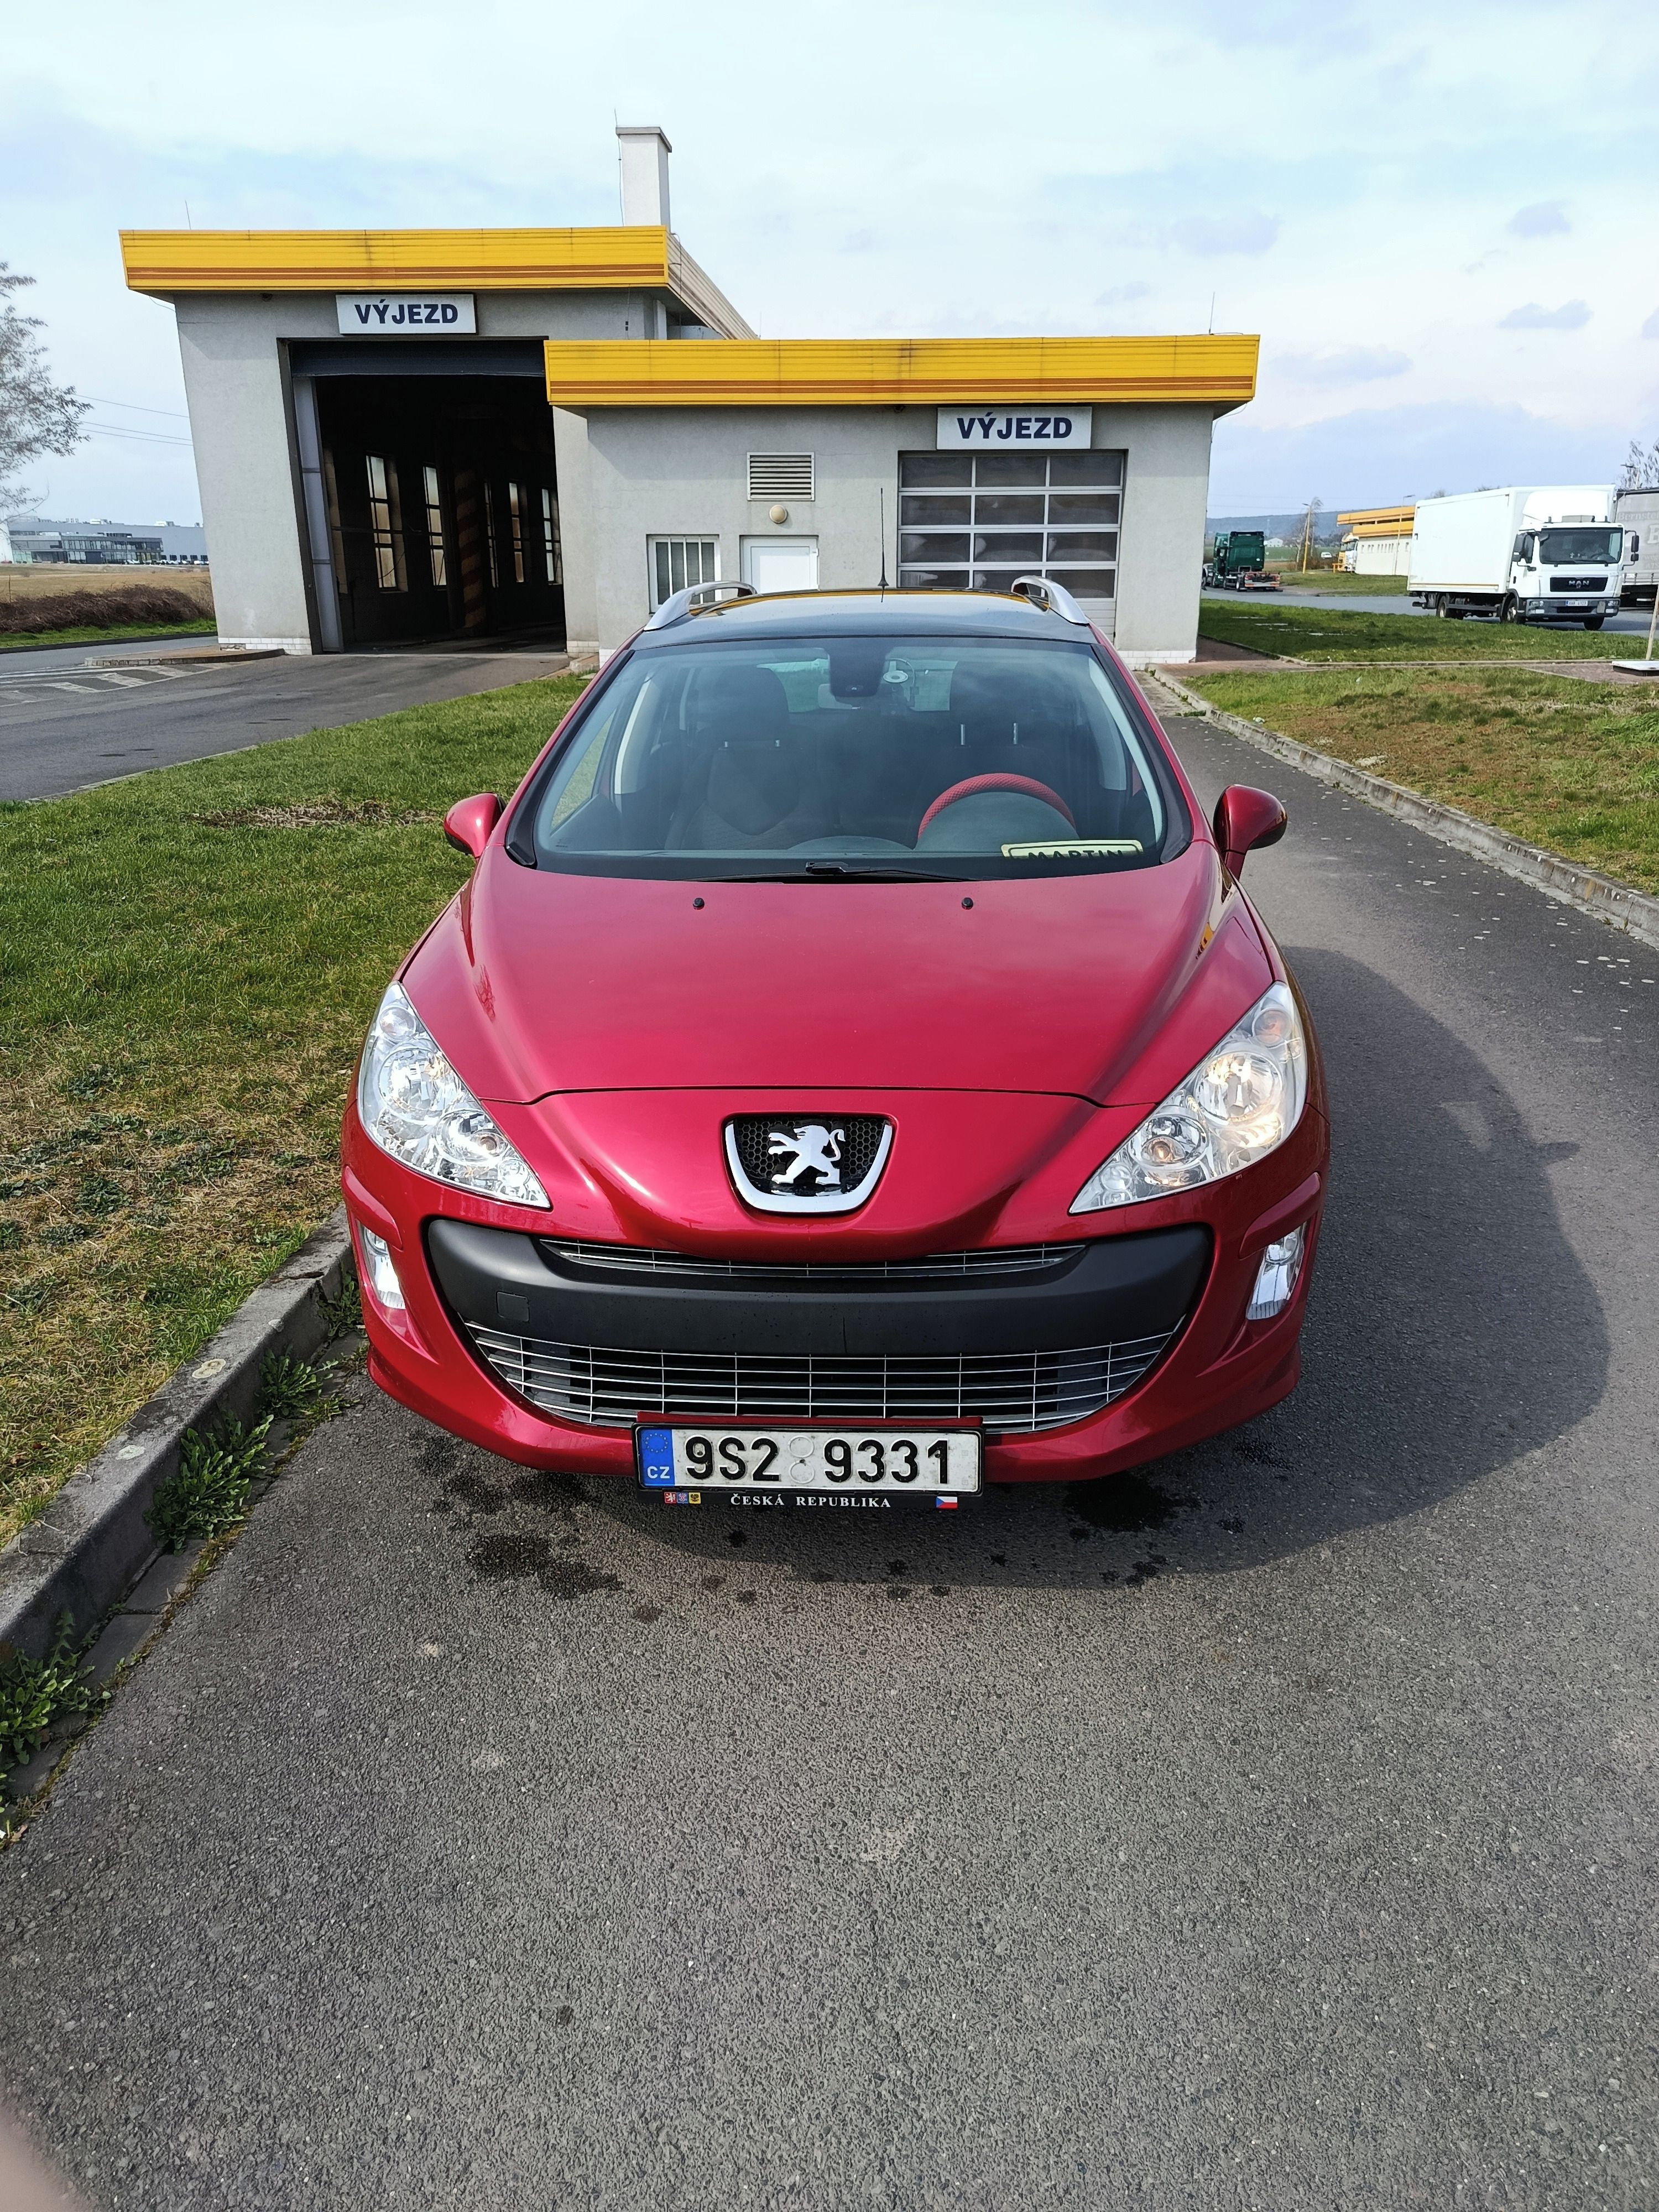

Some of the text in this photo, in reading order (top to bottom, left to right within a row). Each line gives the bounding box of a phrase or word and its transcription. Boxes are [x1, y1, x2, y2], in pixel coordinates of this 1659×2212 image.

[354, 299, 458, 324] VÝJEZD
[957, 411, 1072, 440] VÝJEZD
[647, 1466, 670, 1479] CZ
[685, 1436, 949, 1484] 9S2 9331
[731, 1493, 891, 1507] ČESKÁ REPUBLIKA
